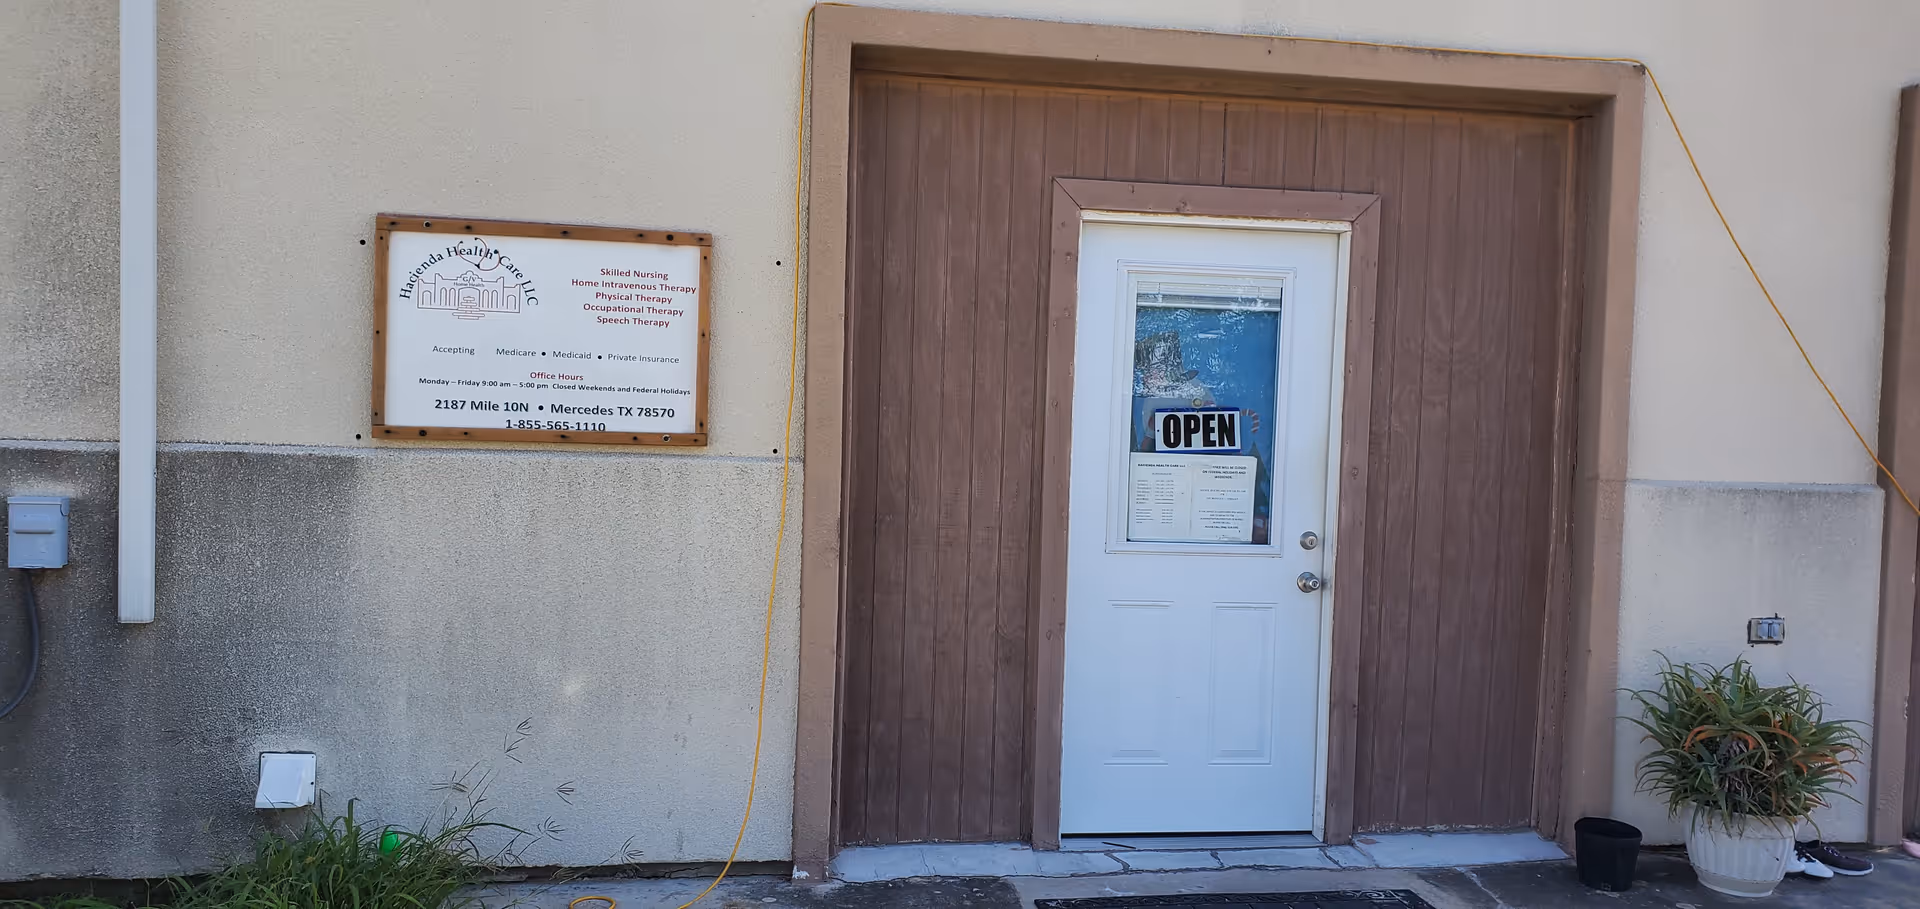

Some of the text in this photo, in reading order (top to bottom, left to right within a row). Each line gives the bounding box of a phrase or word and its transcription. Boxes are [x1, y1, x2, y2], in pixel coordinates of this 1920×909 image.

[400, 246, 538, 306] Hacienda Health Care LLC
[600, 268, 669, 281] Skilled Nursing
[571, 279, 696, 294] Home Intravenous Therapy
[596, 292, 672, 304] Physical Therapy
[583, 303, 684, 317] Occupational Therapy
[597, 316, 670, 328] Speech Therapy
[432, 345, 680, 364] Accepting Medicare Medicaid Private Insurance
[530, 371, 584, 381] Office Hours
[419, 377, 450, 386] Monday
[457, 379, 480, 387] Friday
[519, 381, 535, 389] 5:00
[552, 382, 576, 391] Closed
[578, 384, 615, 392] Weekends
[617, 385, 631, 393] and
[633, 385, 659, 394] Federal
[660, 387, 691, 396] Holidays
[434, 399, 675, 418] 2187 Mile 10N Mercedes TX 78570
[506, 419, 606, 432] 1-855-565-1110
[1163, 414, 1236, 448] OPEN
